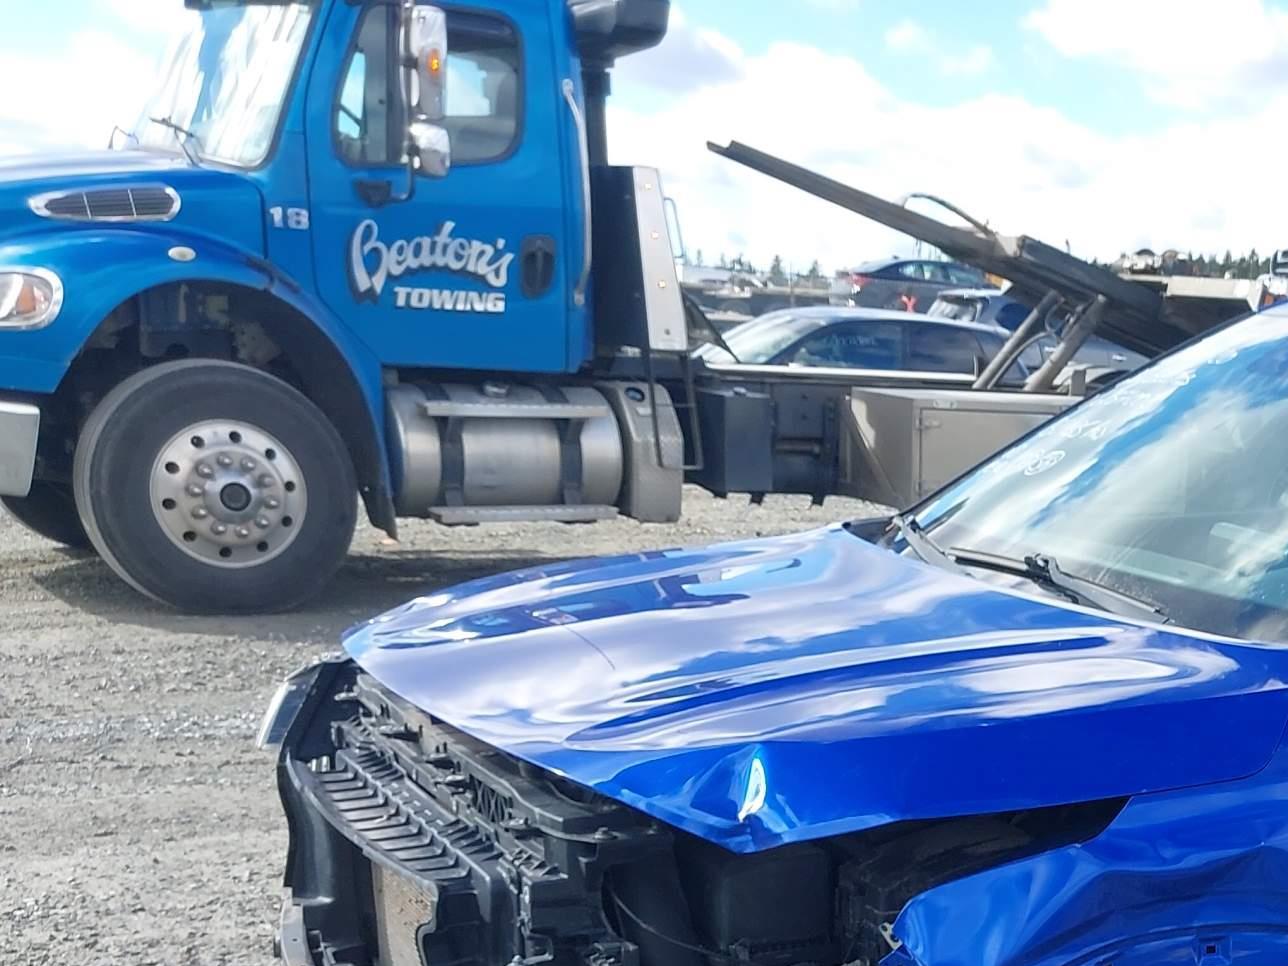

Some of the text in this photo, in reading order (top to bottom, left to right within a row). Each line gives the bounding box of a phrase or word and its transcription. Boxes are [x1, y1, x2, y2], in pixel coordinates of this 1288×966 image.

[269, 206, 309, 230] 18
[351, 219, 515, 295] Beaton's
[393, 287, 506, 313] TOWING
